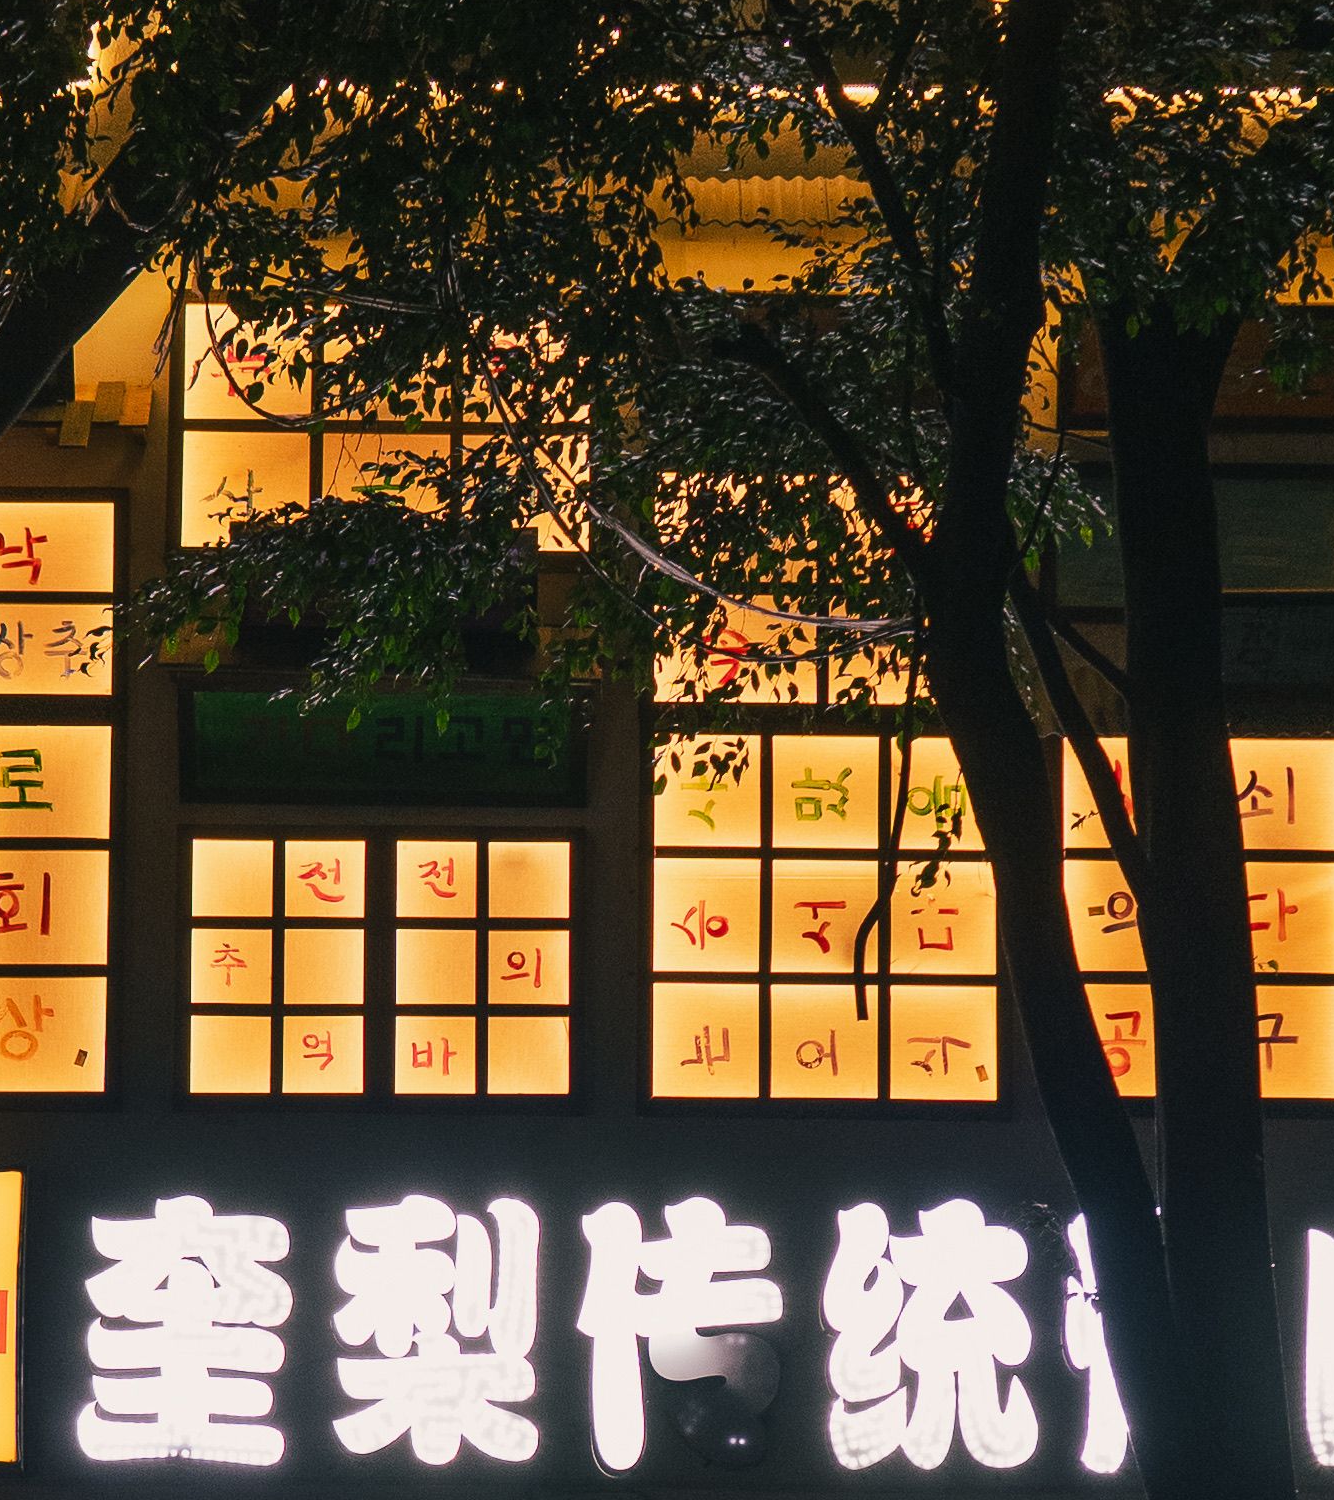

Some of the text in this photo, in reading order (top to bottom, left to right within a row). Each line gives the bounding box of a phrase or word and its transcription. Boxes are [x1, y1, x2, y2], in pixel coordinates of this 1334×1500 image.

[297, 855, 460, 903] 전 전
[499, 949, 544, 989] 의
[410, 1038, 460, 1077] 바
